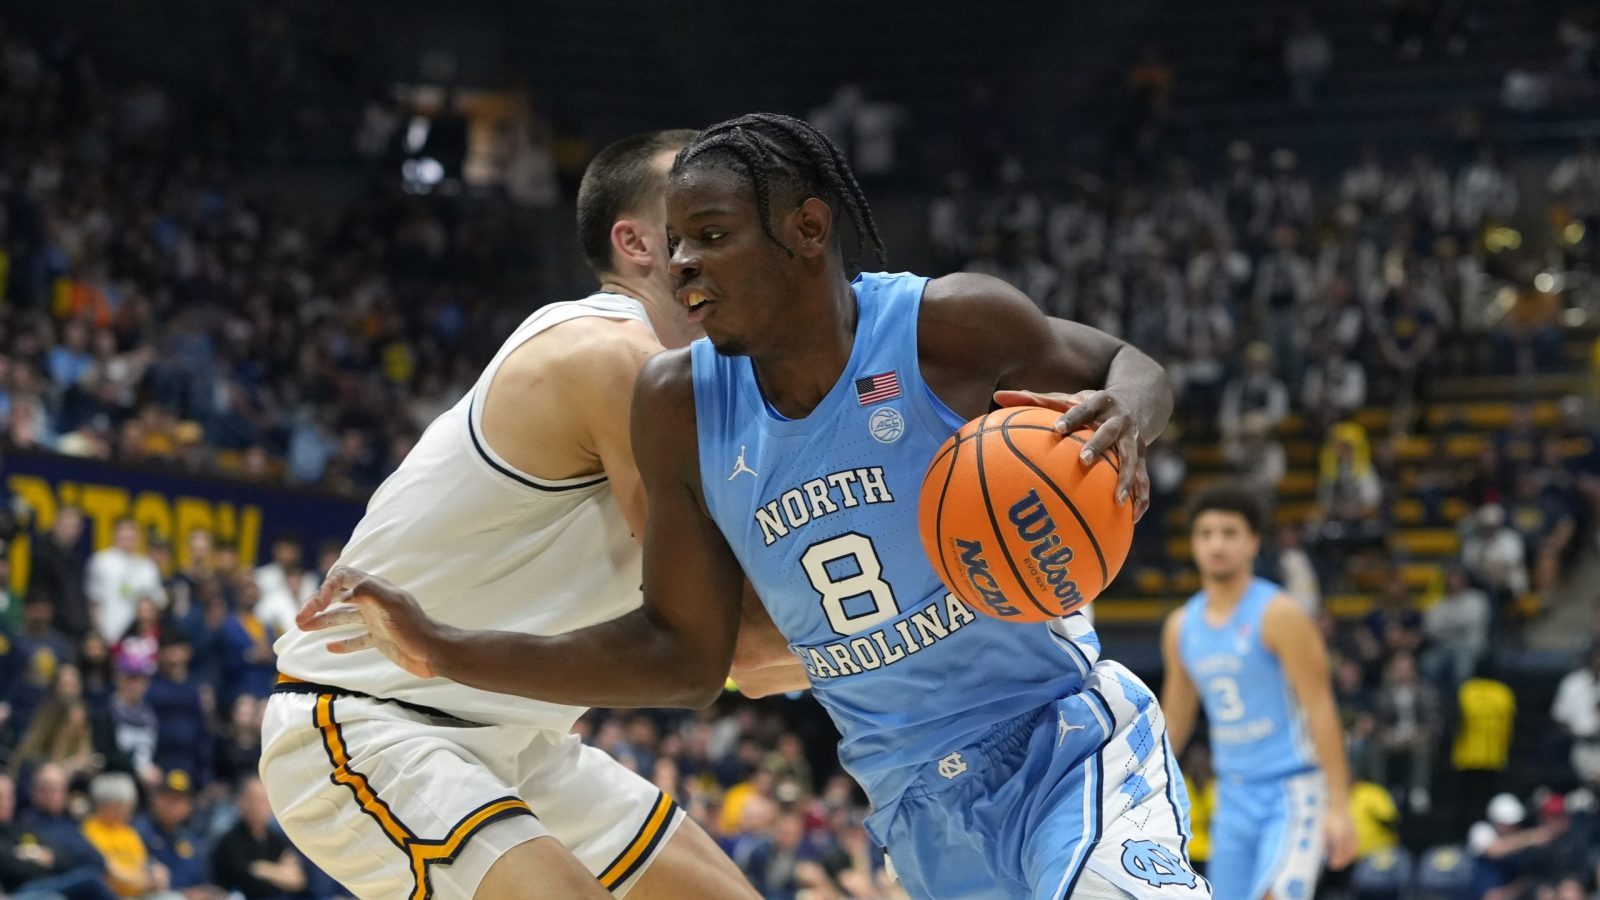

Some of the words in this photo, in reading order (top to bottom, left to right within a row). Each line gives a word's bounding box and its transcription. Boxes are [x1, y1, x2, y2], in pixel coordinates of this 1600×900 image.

[755, 466, 895, 547] NORTH
[799, 531, 901, 637] 8
[955, 538, 1023, 616] NCAA
[1008, 488, 1083, 611] Wilson
[1024, 557, 1037, 576] EVO
[1034, 576, 1048, 592] NXT
[1209, 675, 1245, 722] 3
